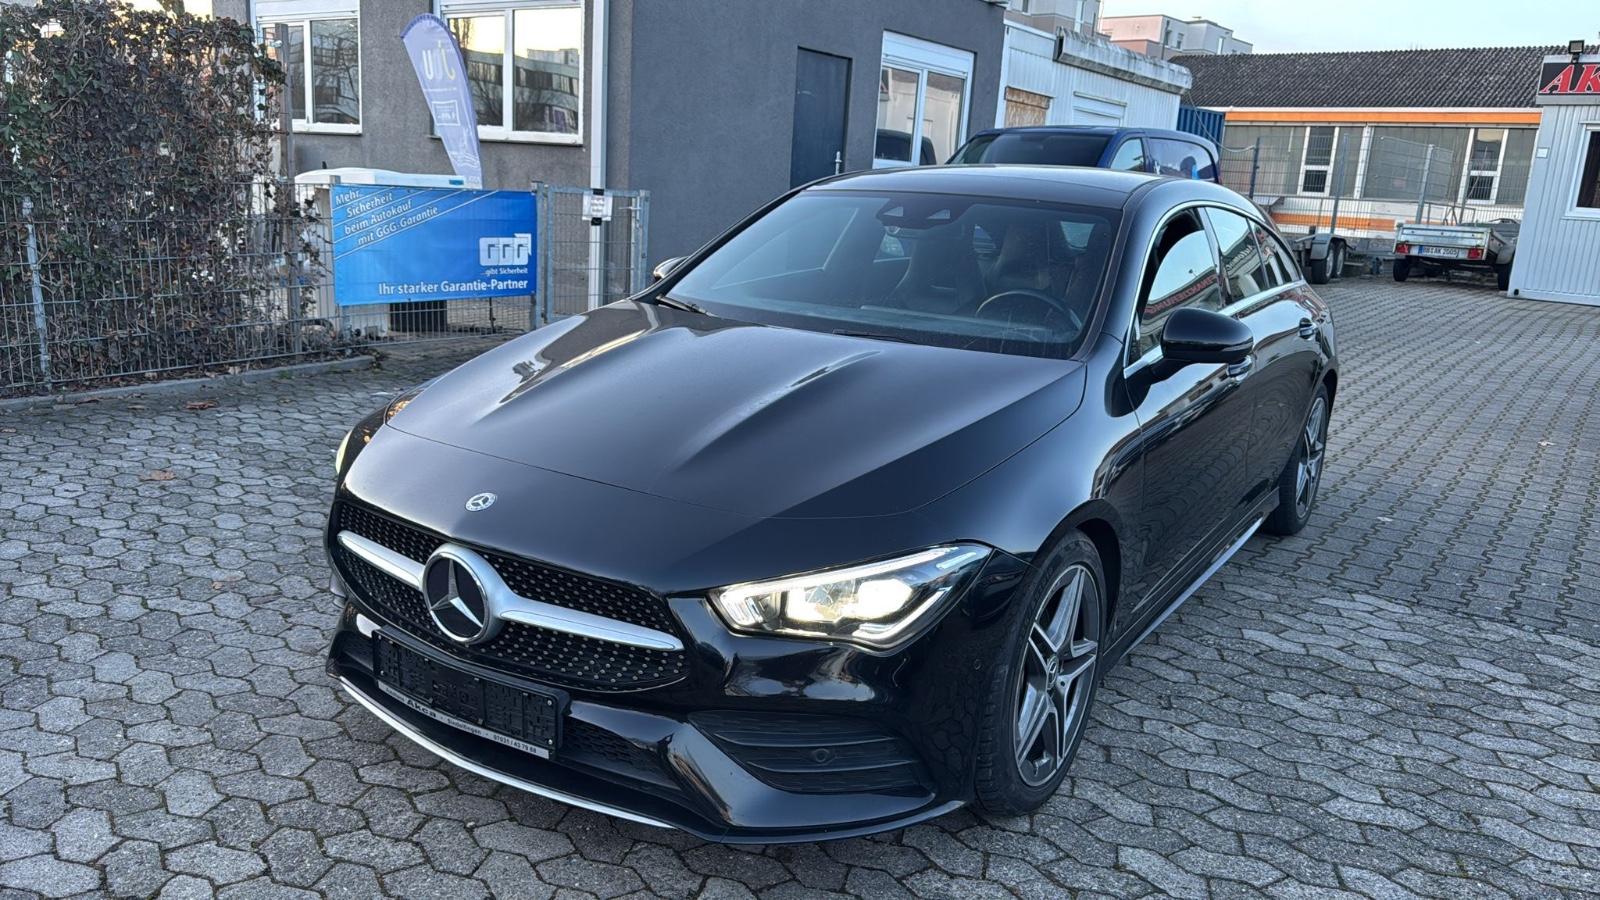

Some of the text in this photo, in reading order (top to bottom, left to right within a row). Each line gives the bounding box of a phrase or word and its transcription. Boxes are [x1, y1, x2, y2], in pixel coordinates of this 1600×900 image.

[335, 190, 360, 205] Mehr
[346, 193, 393, 217] Sicherheit
[344, 199, 413, 235] beim Autokauf
[358, 232, 374, 246] mit
[378, 279, 528, 295] Ihr starker Garantie-Partner
